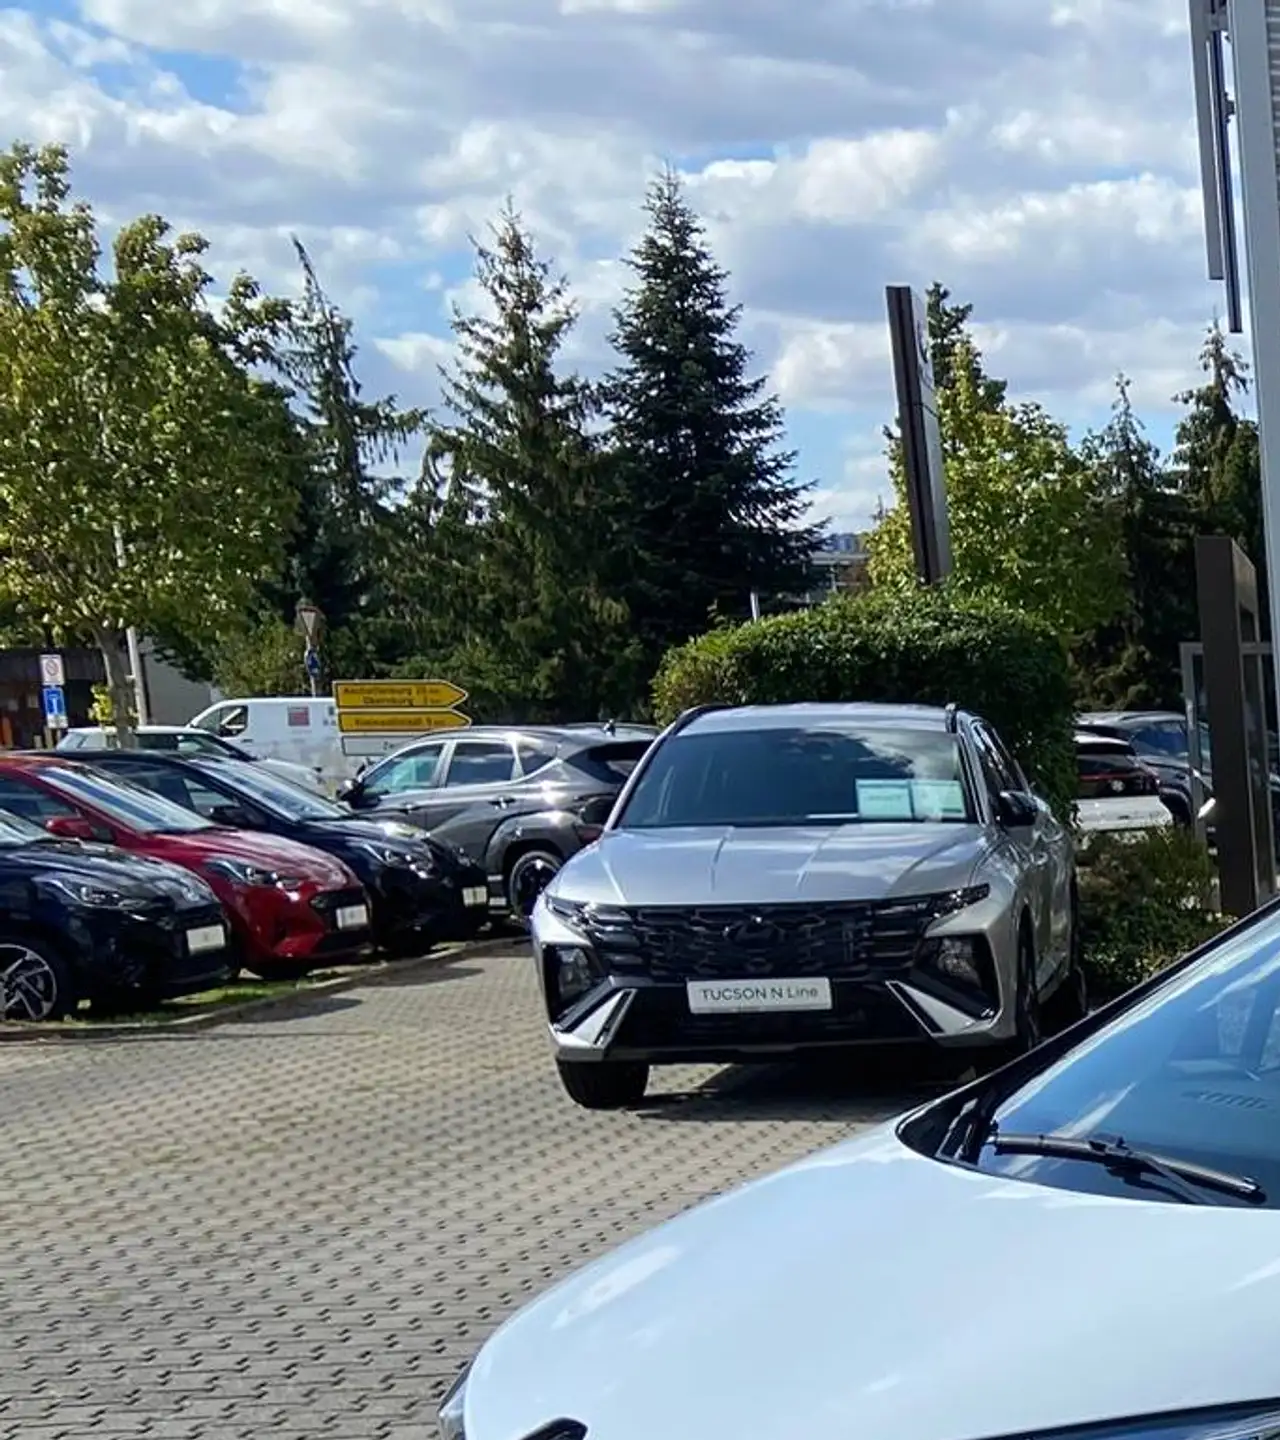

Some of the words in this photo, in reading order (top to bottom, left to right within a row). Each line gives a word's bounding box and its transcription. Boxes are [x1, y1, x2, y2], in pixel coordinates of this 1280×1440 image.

[702, 987, 767, 1001] TUCSON
[770, 987, 783, 999] N
[787, 986, 819, 999] Line
